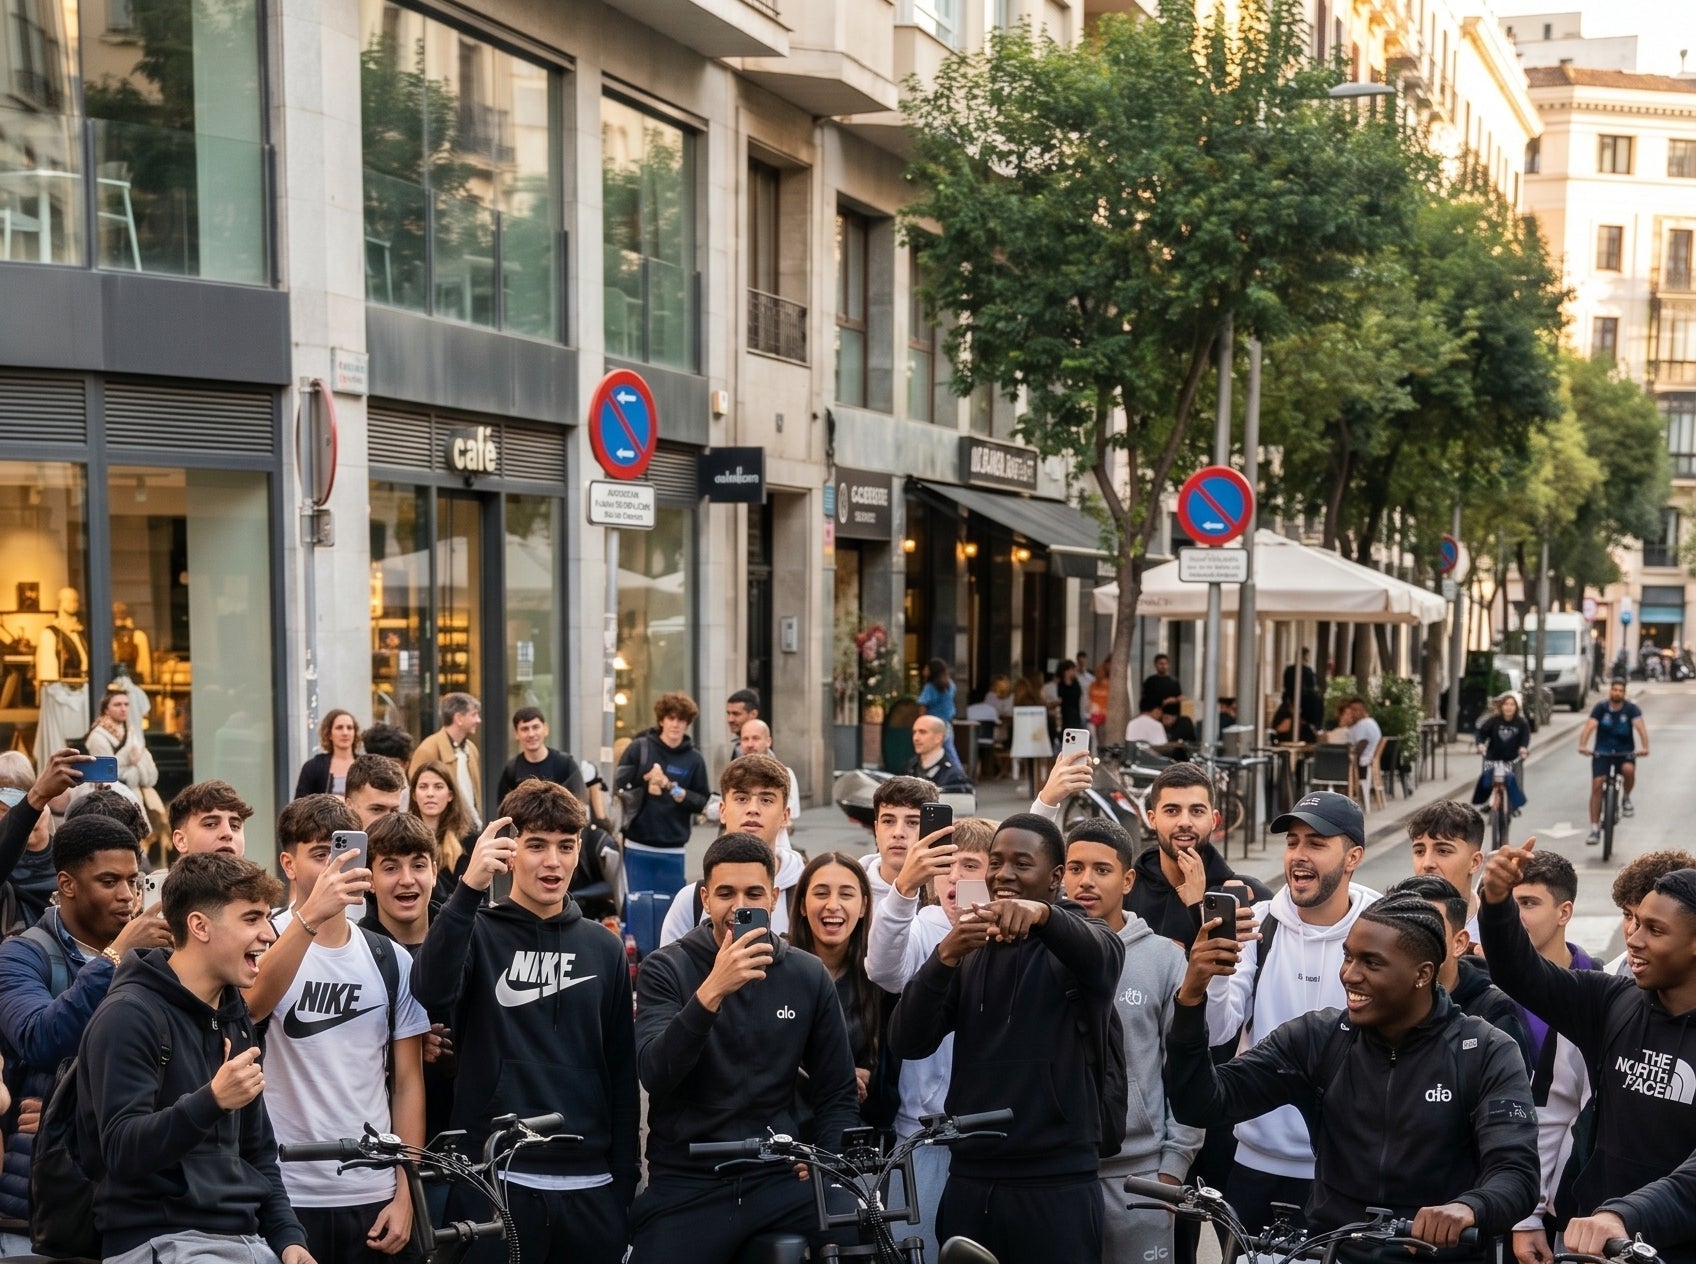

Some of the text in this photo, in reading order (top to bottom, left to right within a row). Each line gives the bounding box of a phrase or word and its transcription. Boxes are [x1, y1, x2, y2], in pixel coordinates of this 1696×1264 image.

[509, 950, 577, 986] NIKE
[297, 980, 363, 1015] NIKE
[776, 1005, 796, 1019] alo
[1642, 1049, 1673, 1070] THE
[1622, 1074, 1667, 1098] FACE
